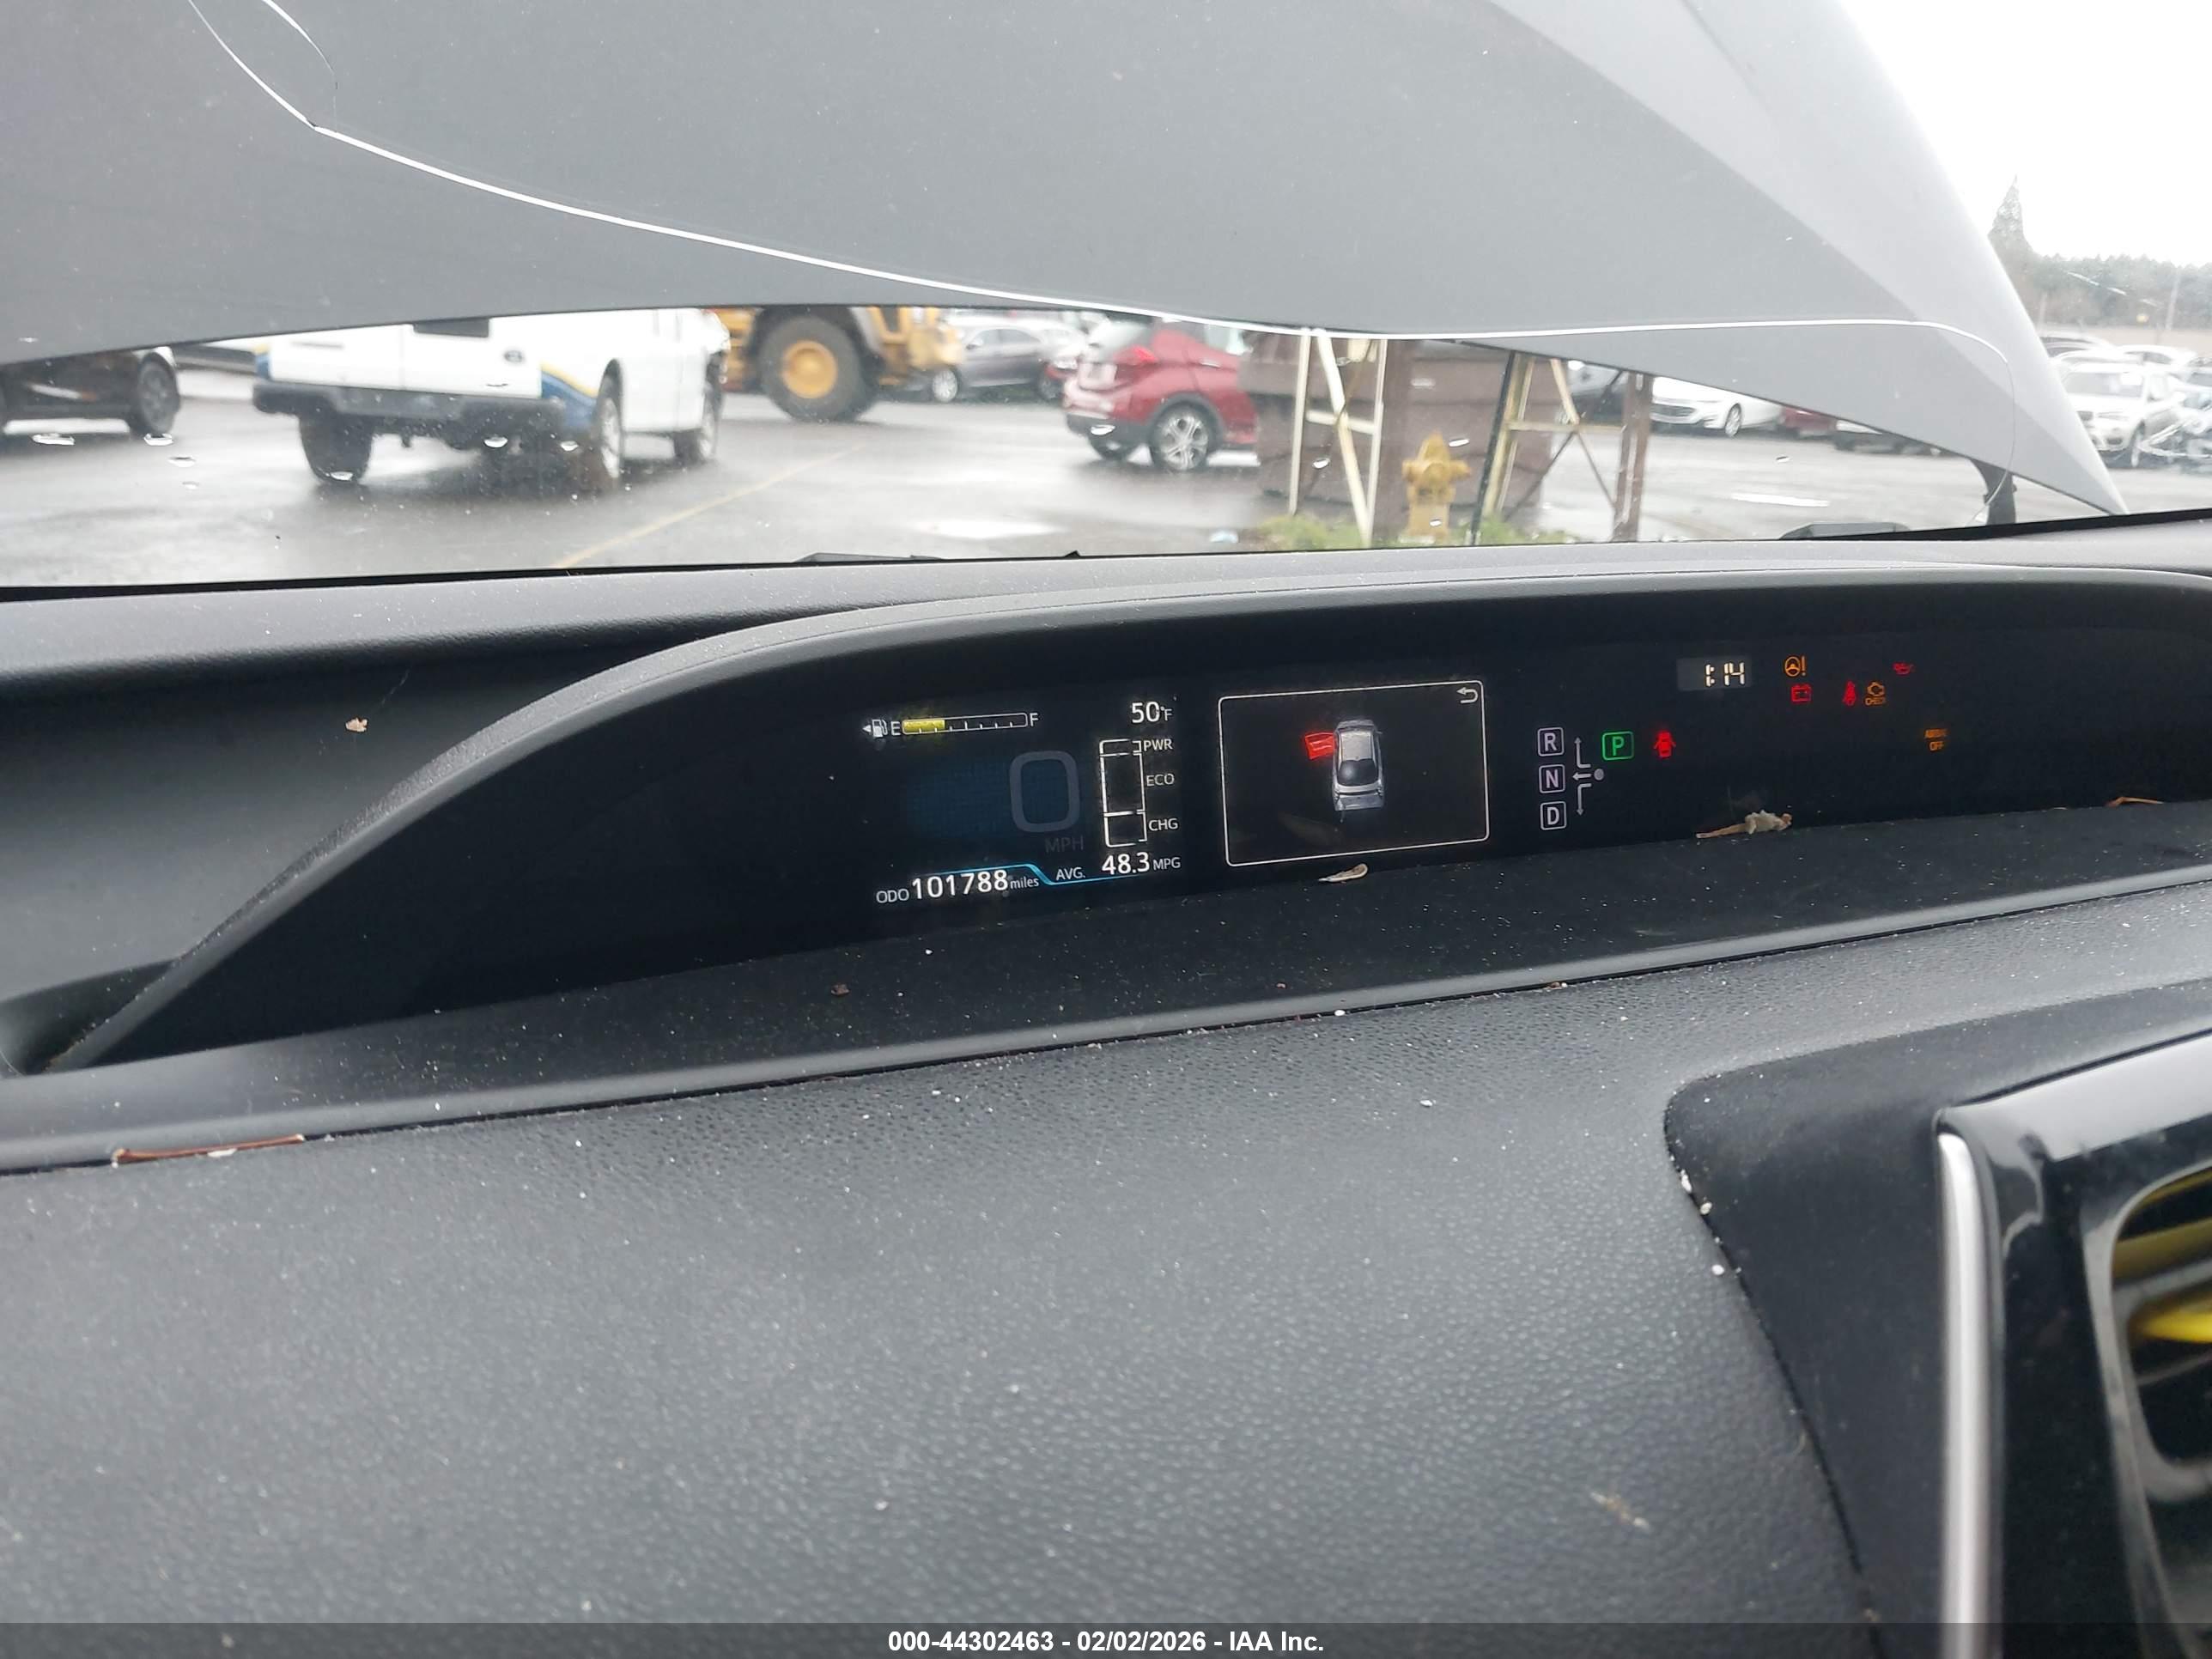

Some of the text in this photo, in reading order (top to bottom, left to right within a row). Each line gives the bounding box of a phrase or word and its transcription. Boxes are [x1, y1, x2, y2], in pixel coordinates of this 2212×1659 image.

[890, 720, 902, 736] E
[1030, 712, 1039, 727] F
[1143, 738, 1173, 752] PWR
[1544, 732, 1557, 751] R
[1612, 736, 1625, 756] P
[1146, 773, 1175, 787] ECO
[1545, 769, 1559, 788] N
[1009, 750, 1080, 833] 0
[1148, 817, 1179, 831] CHG
[1547, 806, 1560, 825] D
[1045, 836, 1085, 854] MPH
[1055, 852, 1182, 881] AVG. 48.3 MPG
[876, 870, 1039, 905] ODO 101788 miles
